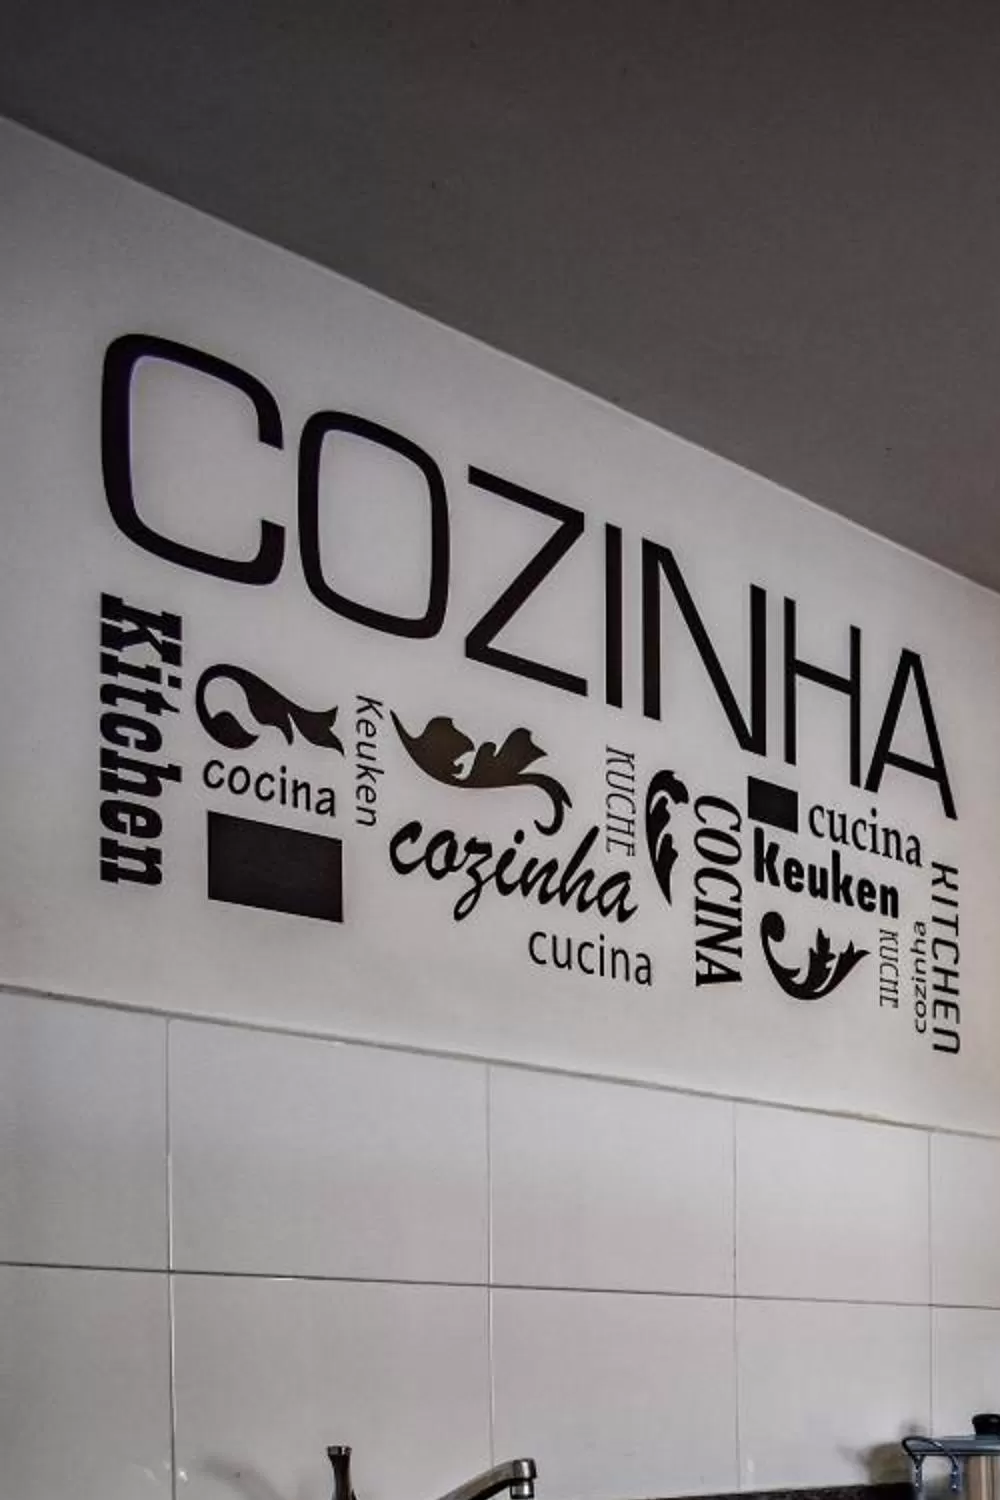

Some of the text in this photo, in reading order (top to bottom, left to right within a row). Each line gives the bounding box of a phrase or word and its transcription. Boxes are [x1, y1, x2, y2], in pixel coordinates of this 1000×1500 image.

[100, 331, 958, 820] COZINHA
[100, 591, 183, 887] Kitchen
[203, 759, 336, 818] cocina
[355, 695, 385, 827] Keuken
[389, 820, 639, 923] cozinha
[693, 795, 743, 987] COCINA
[808, 804, 923, 868] cucina
[528, 931, 652, 987] cucina
[910, 920, 927, 1034] cozinha
